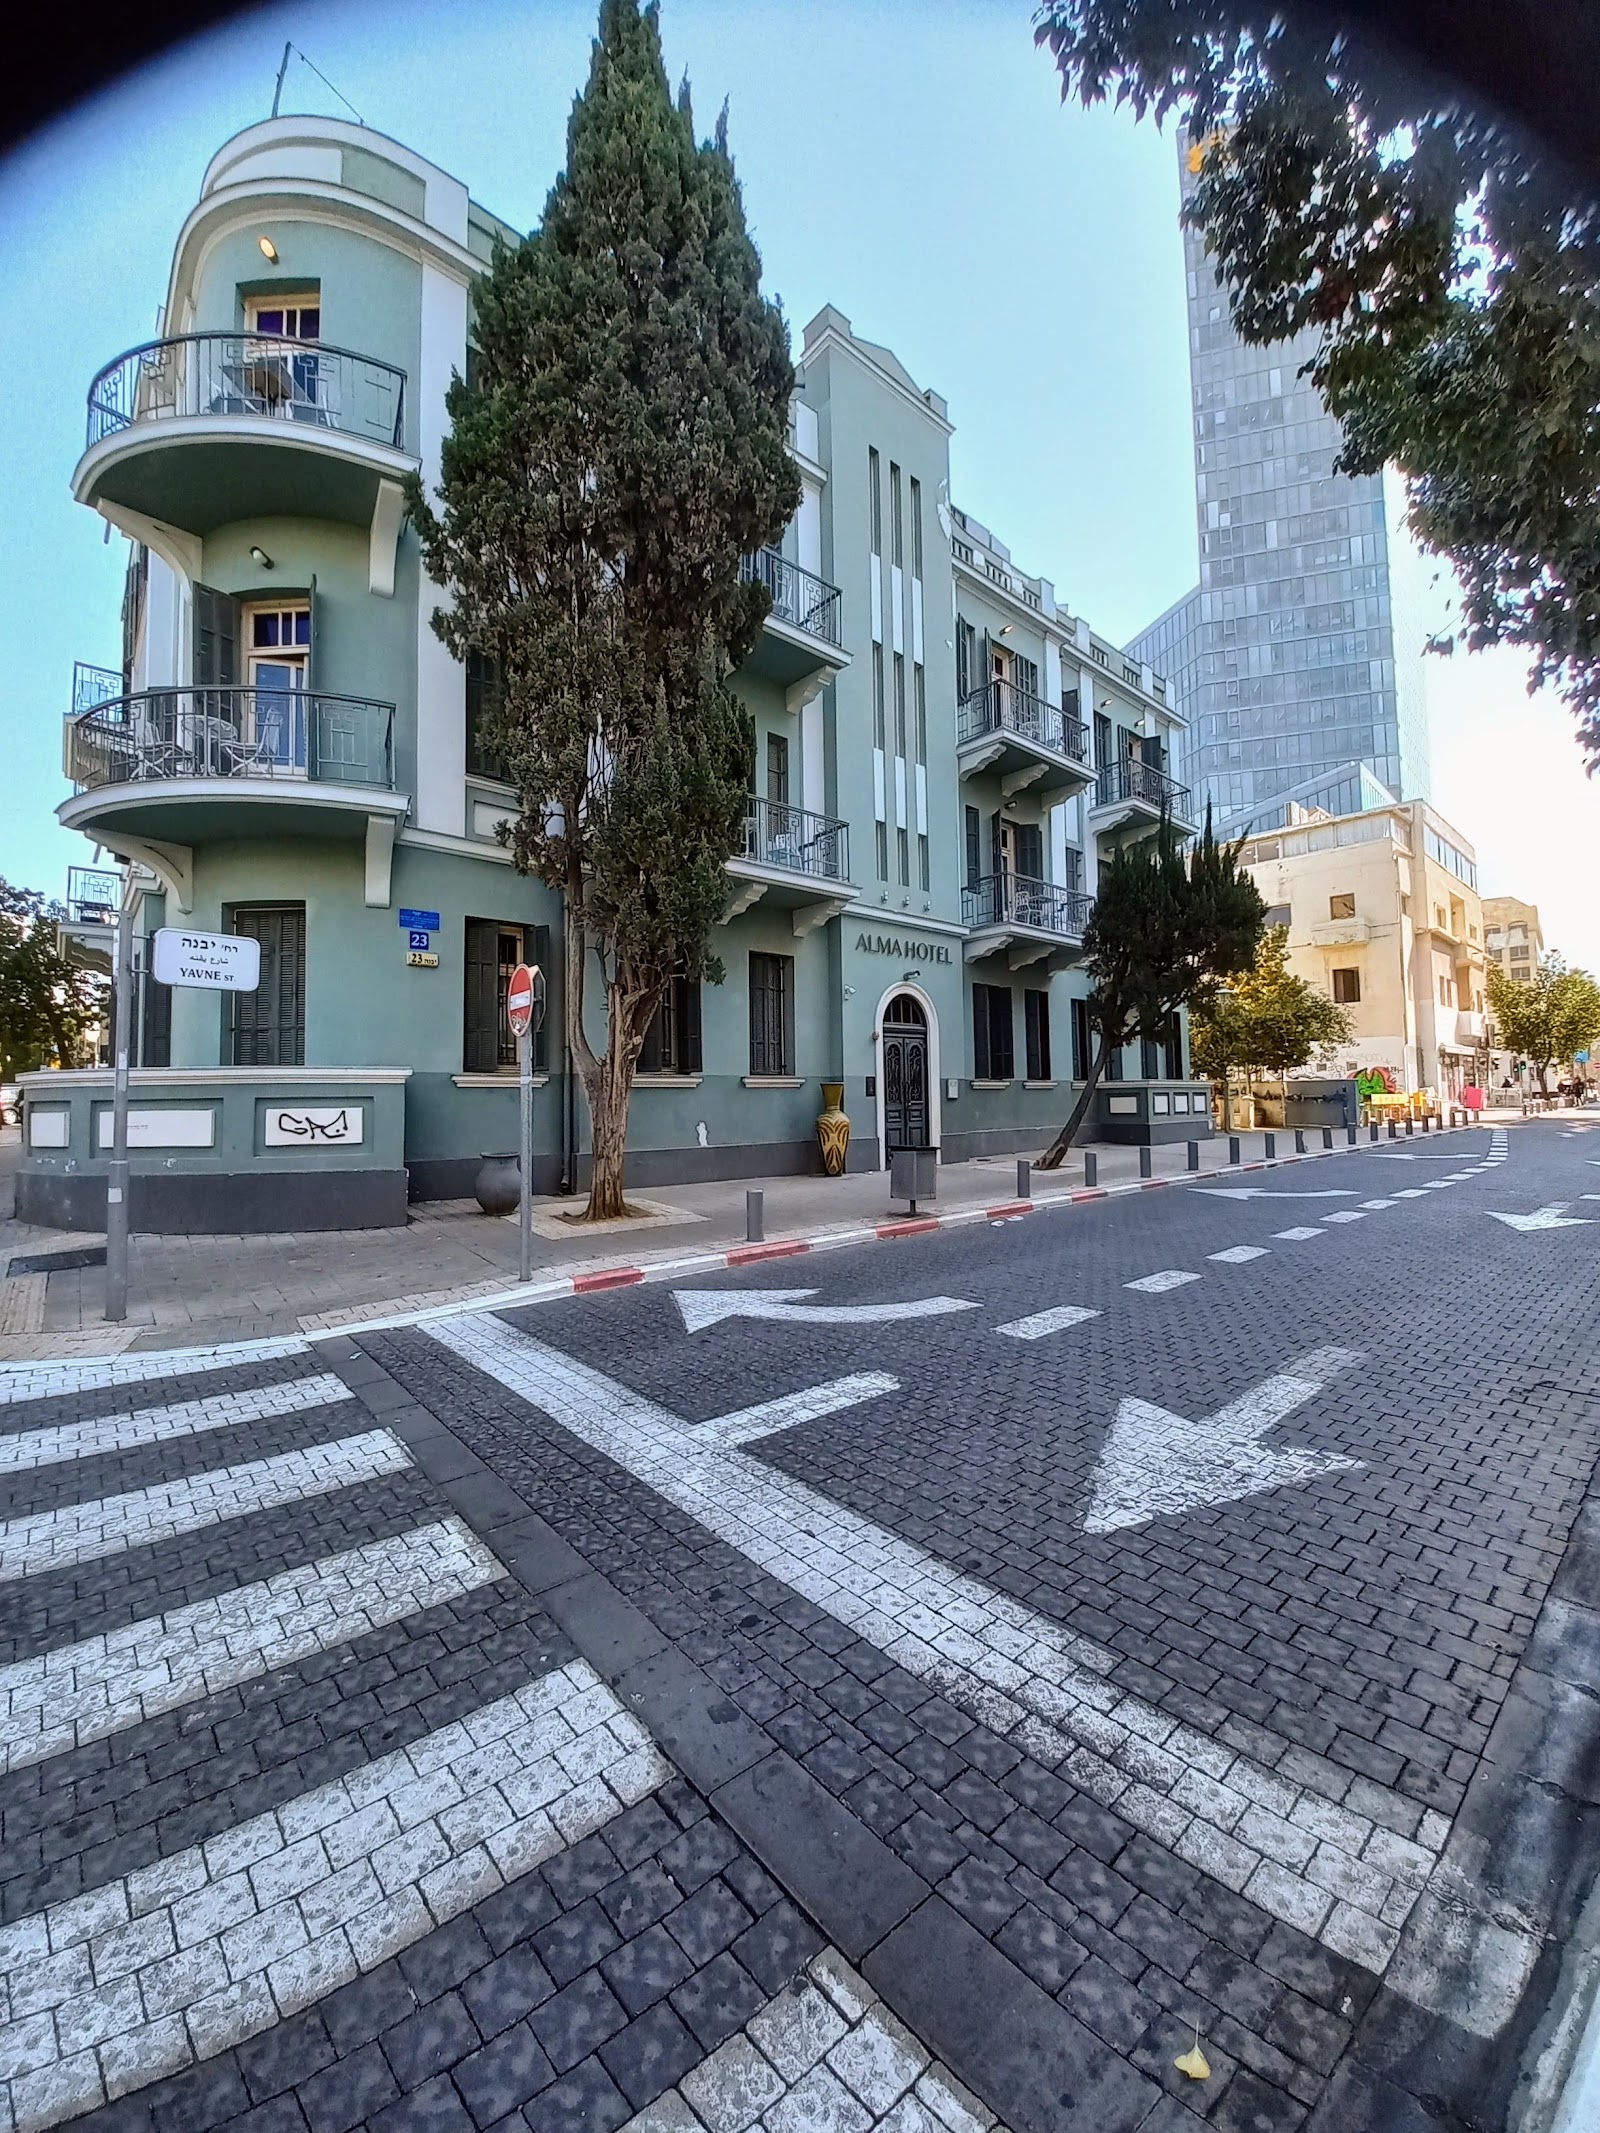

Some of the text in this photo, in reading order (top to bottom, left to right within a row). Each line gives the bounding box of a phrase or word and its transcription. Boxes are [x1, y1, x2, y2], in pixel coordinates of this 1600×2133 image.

[181, 937, 216, 950] יבנה
[411, 934, 428, 946] 23
[855, 933, 953, 965] ALMA HOTEL
[210, 957, 229, 965] شارع
[411, 953, 423, 964] 23
[179, 967, 222, 981] YAVNE
